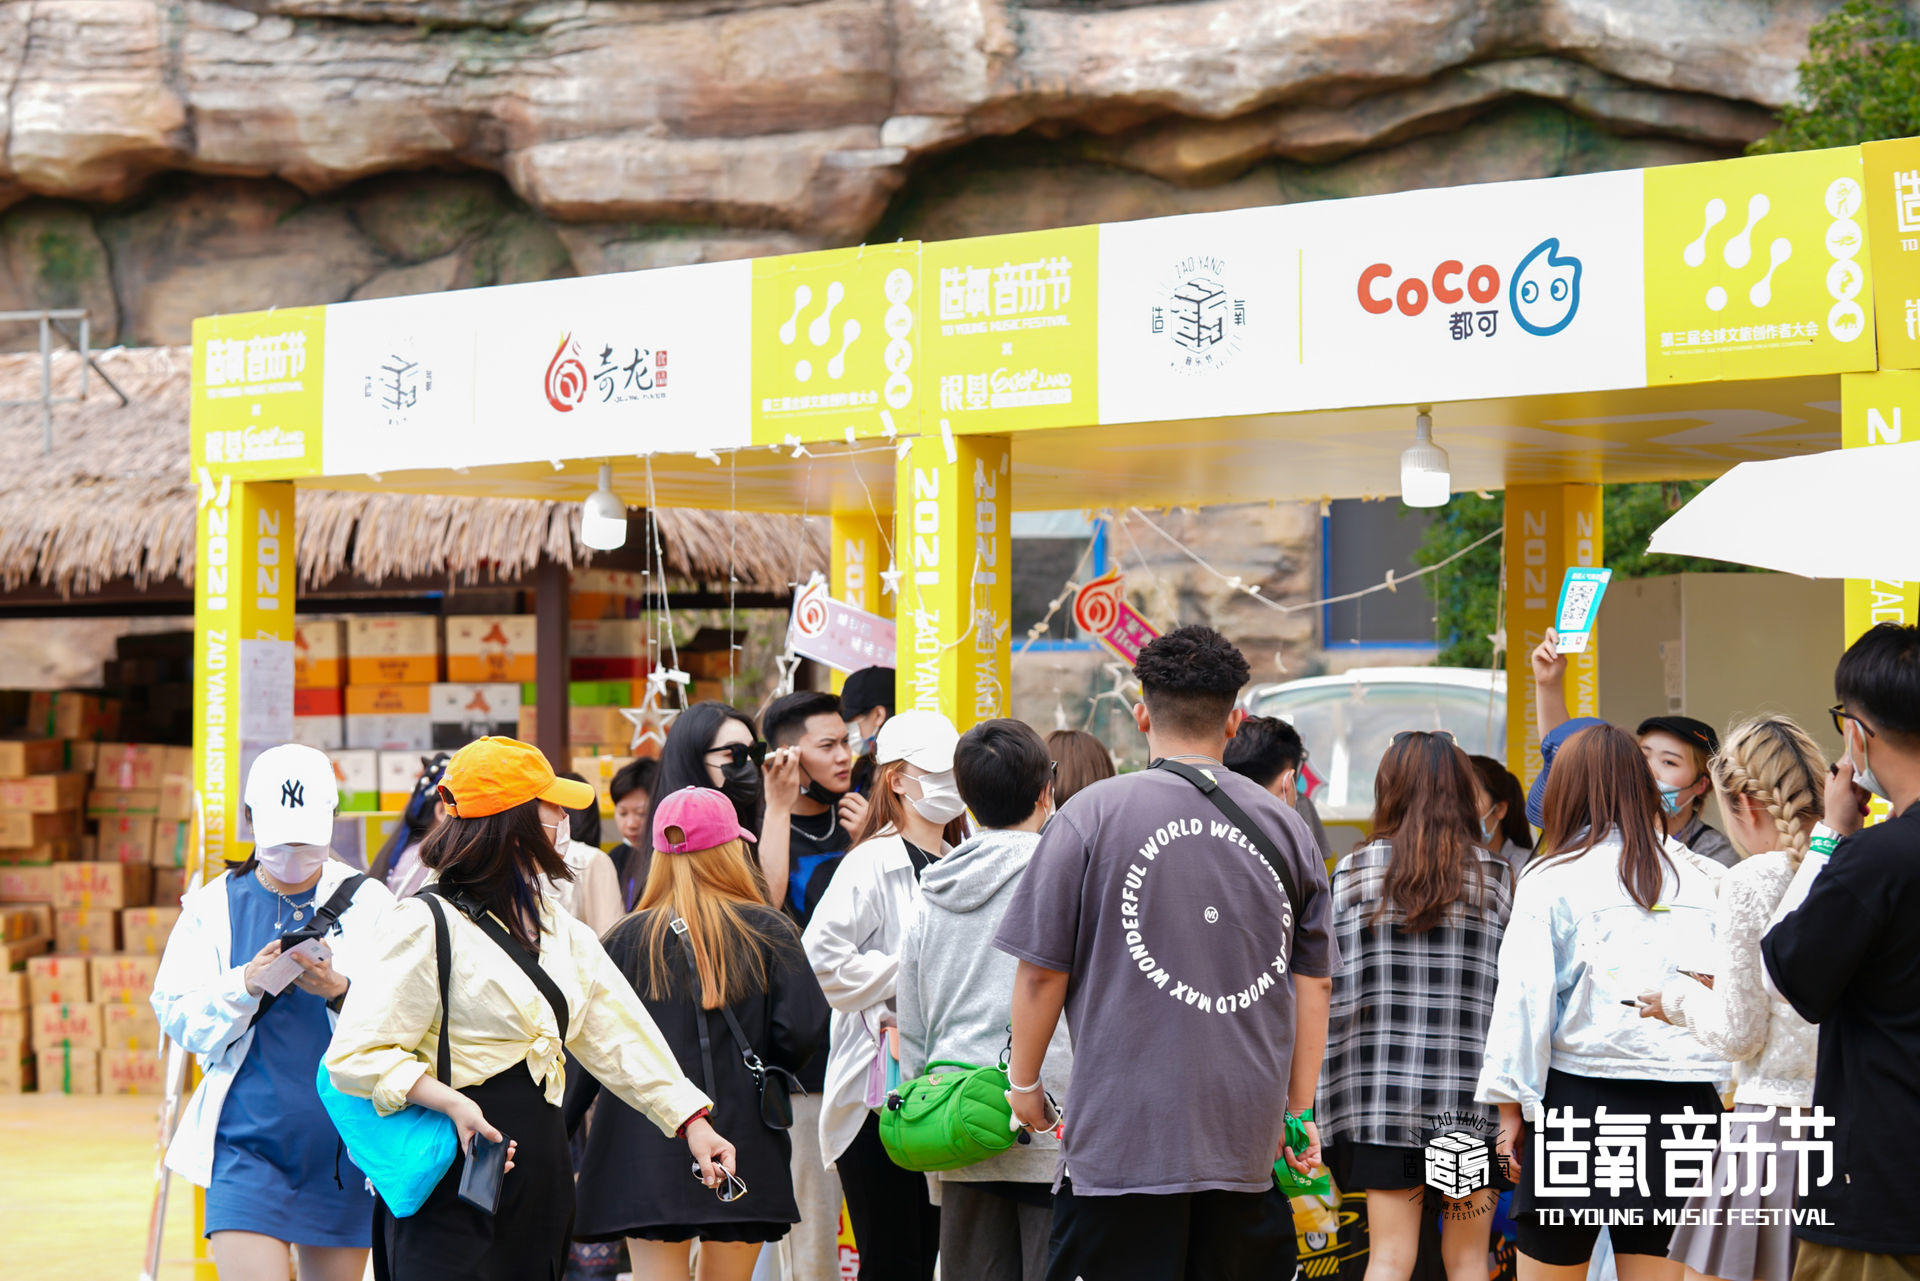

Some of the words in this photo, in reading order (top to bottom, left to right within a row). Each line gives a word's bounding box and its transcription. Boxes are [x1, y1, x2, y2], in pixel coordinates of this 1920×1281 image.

[1357, 259, 1500, 317] CoCo
[1449, 310, 1499, 341] 都可
[914, 467, 940, 585] 2021
[1577, 511, 1593, 567] 20
[207, 508, 229, 610] 2021
[256, 508, 280, 610] 2021
[845, 538, 865, 609] 202
[1523, 510, 1546, 610] 2021
[1139, 818, 1203, 861] WORLD
[1121, 863, 1170, 990] WONDERFUL
[1169, 980, 1211, 1014] MAX
[1216, 972, 1275, 1014] WORLD
